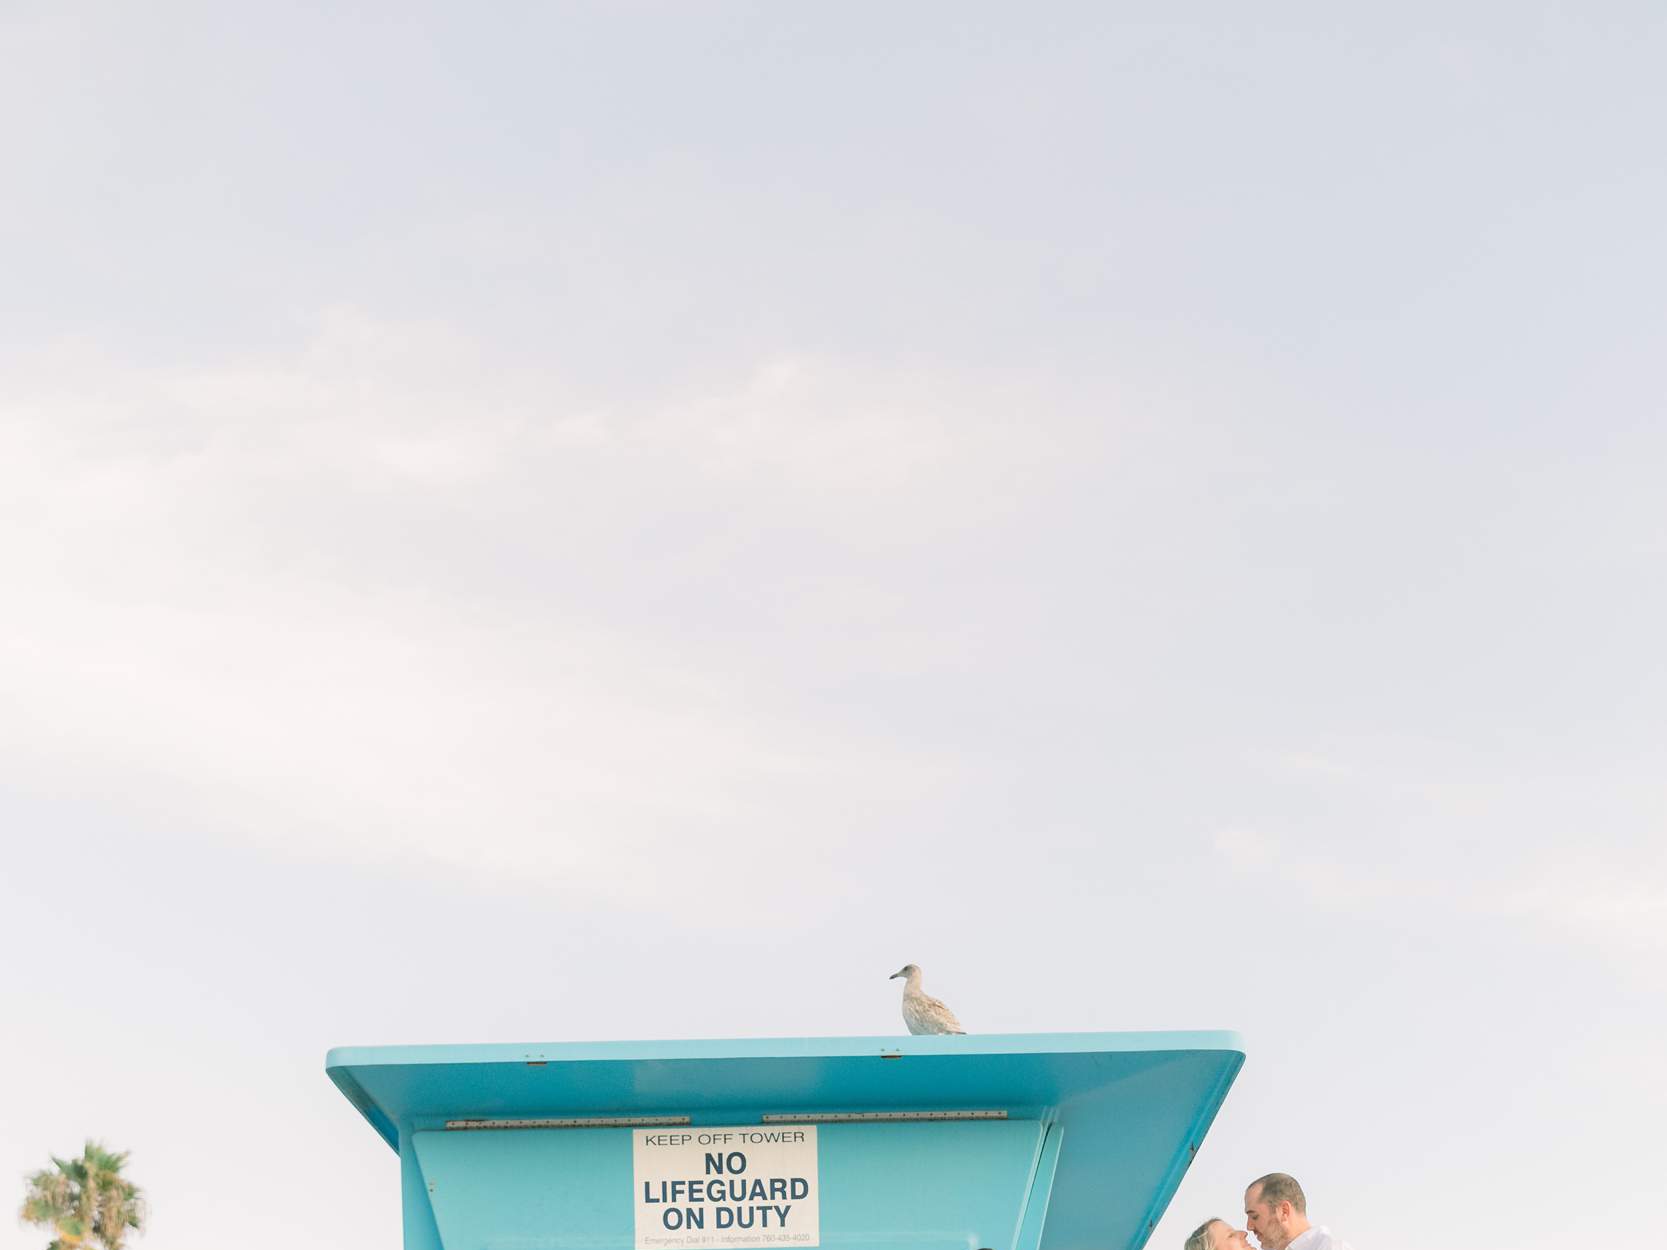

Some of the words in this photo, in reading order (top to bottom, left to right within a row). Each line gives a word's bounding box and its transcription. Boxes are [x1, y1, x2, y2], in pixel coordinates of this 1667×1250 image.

[645, 1134, 692, 1146] KEEP
[698, 1133, 733, 1145] OFF
[739, 1131, 805, 1144] TOWER
[705, 1151, 746, 1175] NO
[644, 1177, 808, 1203] LIFEGUARD
[662, 1207, 704, 1231] ON
[715, 1205, 792, 1229] DUTY
[644, 1236, 684, 1247] Emergency
